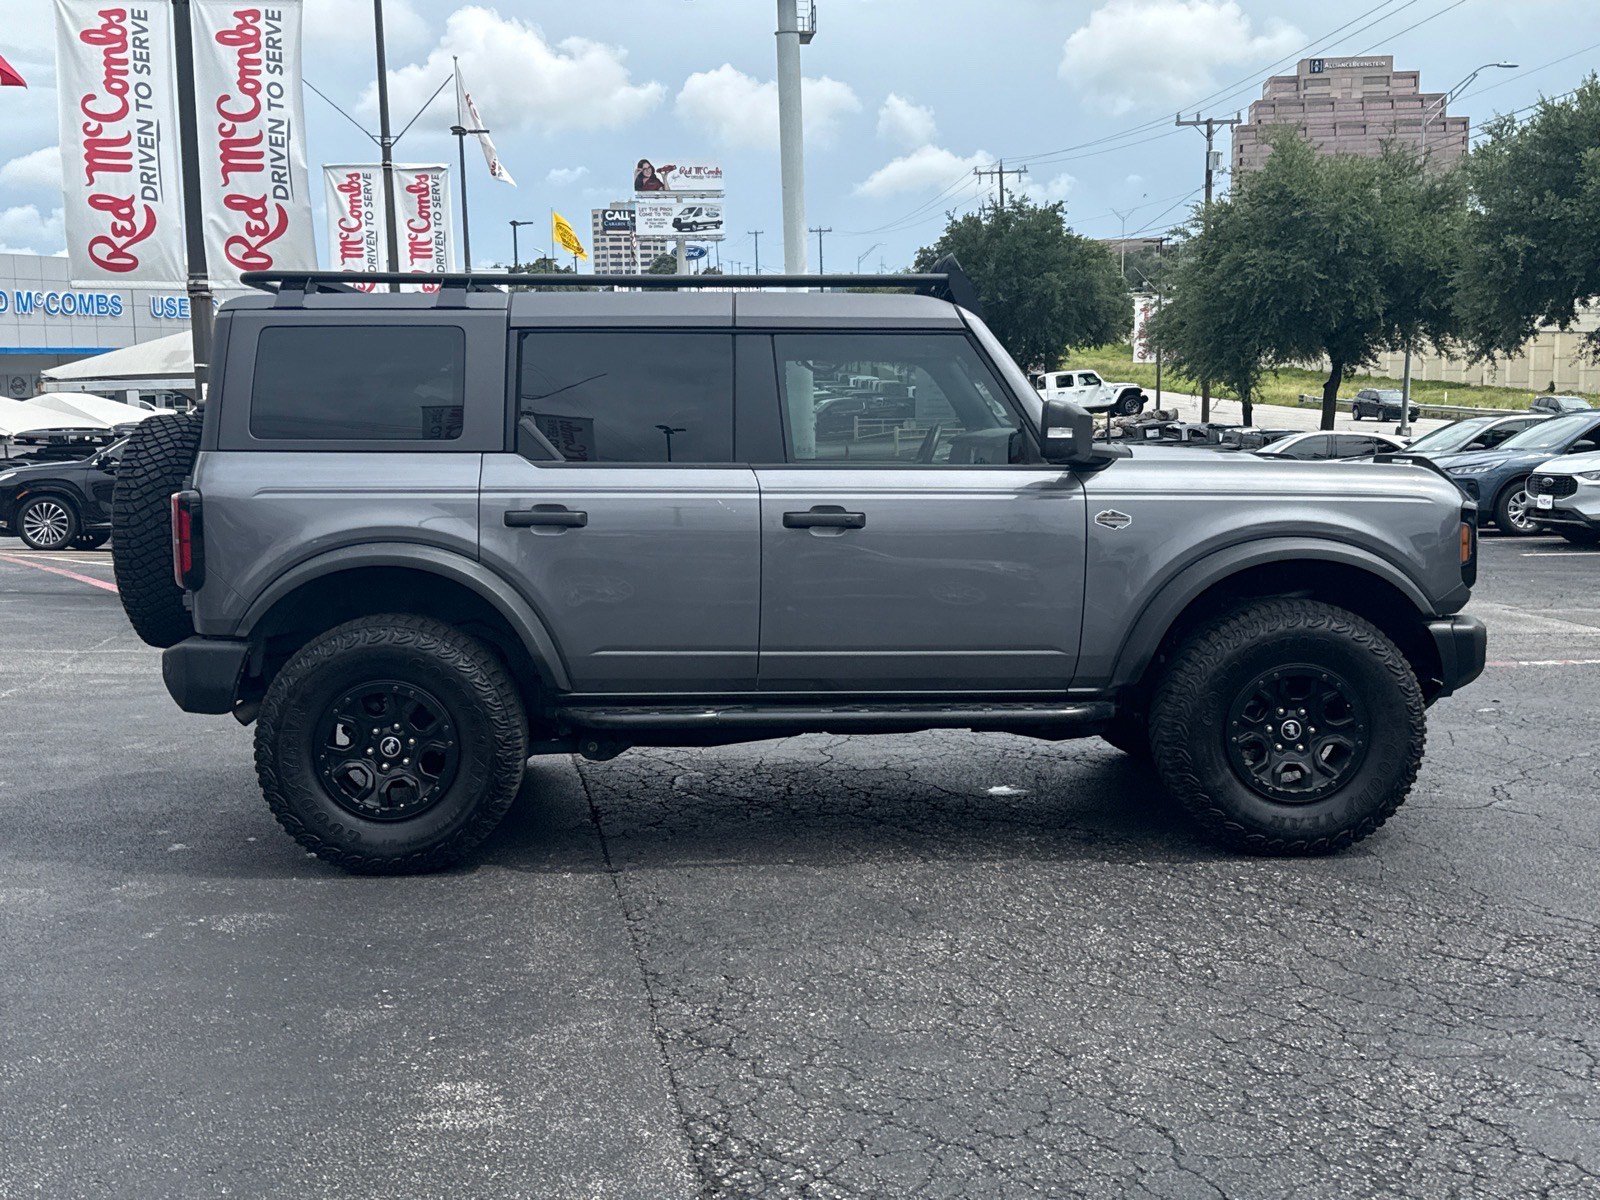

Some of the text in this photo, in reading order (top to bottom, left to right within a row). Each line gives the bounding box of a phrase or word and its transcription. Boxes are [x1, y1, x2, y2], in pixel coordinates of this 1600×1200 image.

[79, 8, 157, 273] Red McCombs
[131, 8, 159, 202] DRIVEN TO SERVE
[215, 9, 289, 272] Red McCombs
[265, 9, 290, 200] DRIVEN TO SERVE
[337, 172, 364, 267] McCombs
[405, 174, 433, 267] McCombs
[679, 166, 692, 178] Red
[362, 172, 377, 273] DRIVEN TO SERVE
[431, 174, 446, 273] DRIVEN TO SERVE
[15, 291, 123, 317] McCOMBS
[152, 297, 191, 318] USE
